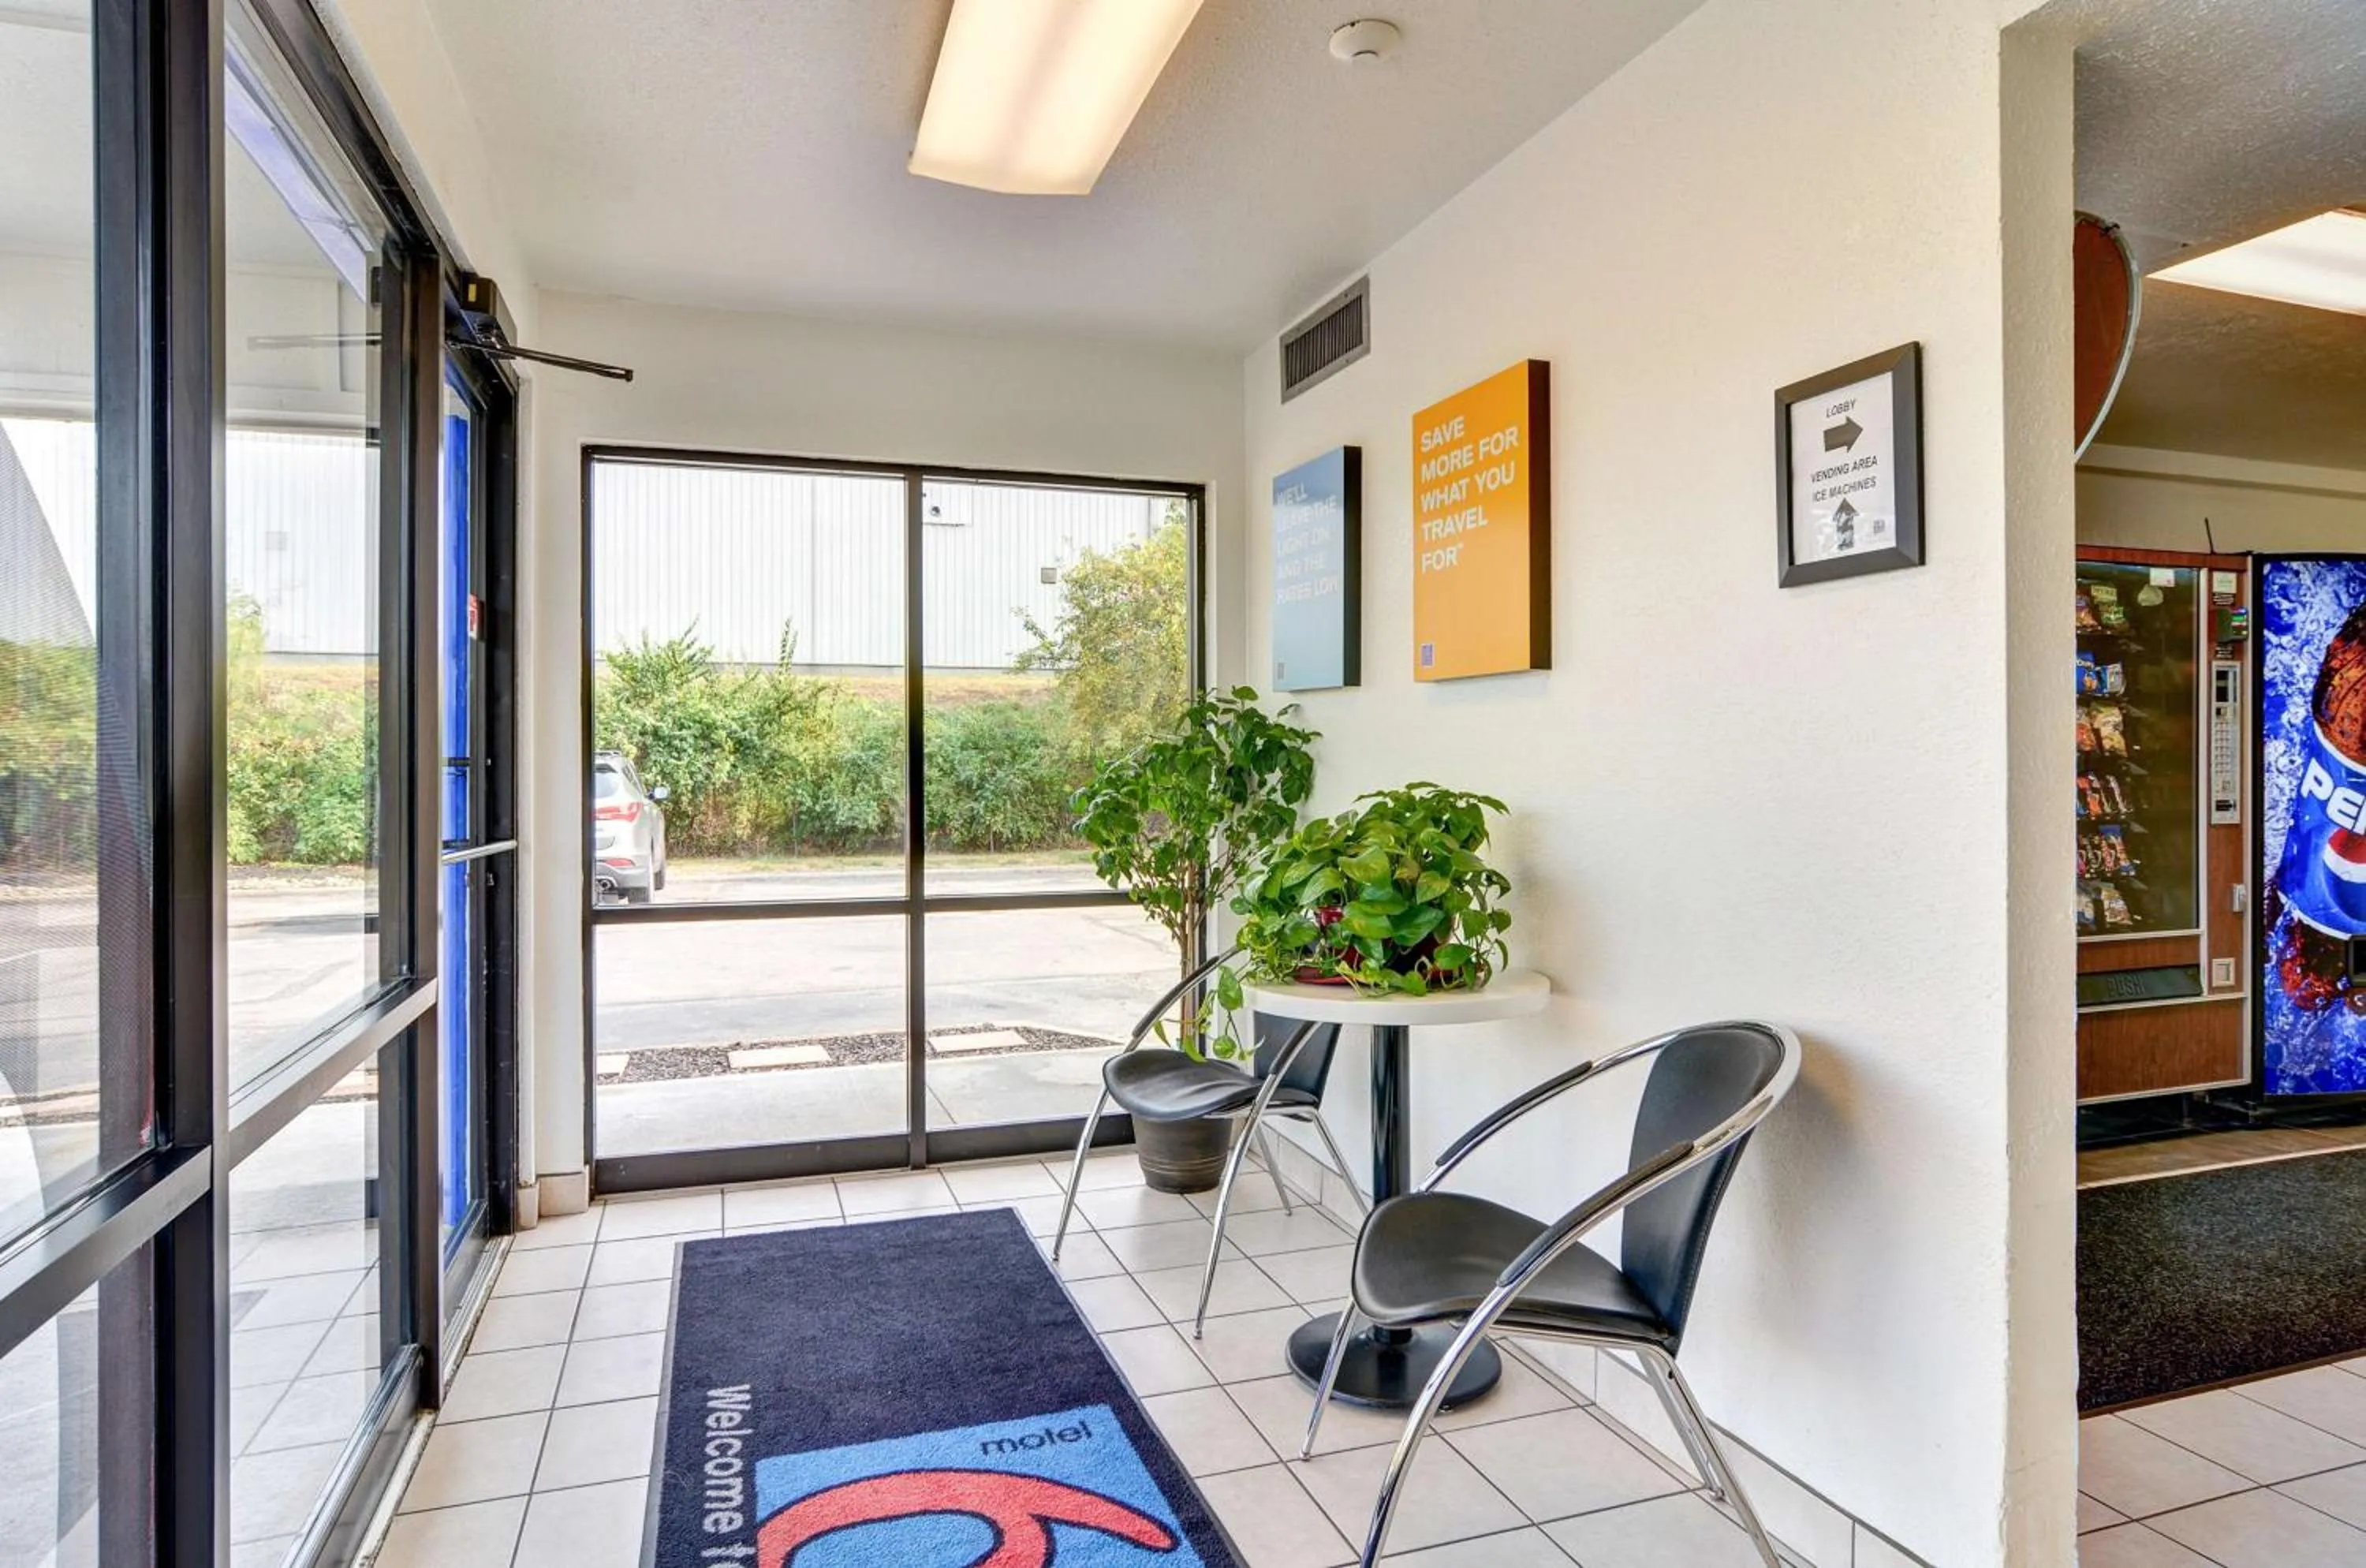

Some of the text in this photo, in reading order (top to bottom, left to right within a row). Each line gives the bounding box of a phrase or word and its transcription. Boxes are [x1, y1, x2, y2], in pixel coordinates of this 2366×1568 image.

[1826, 398, 1857, 418] LOBBY
[1421, 416, 1465, 453] SAVE
[1421, 426, 1519, 483] MORE FOR
[1811, 455, 1878, 483] VENDING AREA
[1421, 461, 1514, 512] WHAT YOU
[1813, 476, 1876, 502] ICE MACHINES
[1313, 495, 1338, 520] THE
[1422, 505, 1488, 542] TRAVEL
[980, 1419, 1092, 1456] motel
[703, 1383, 753, 1534] Welcome
